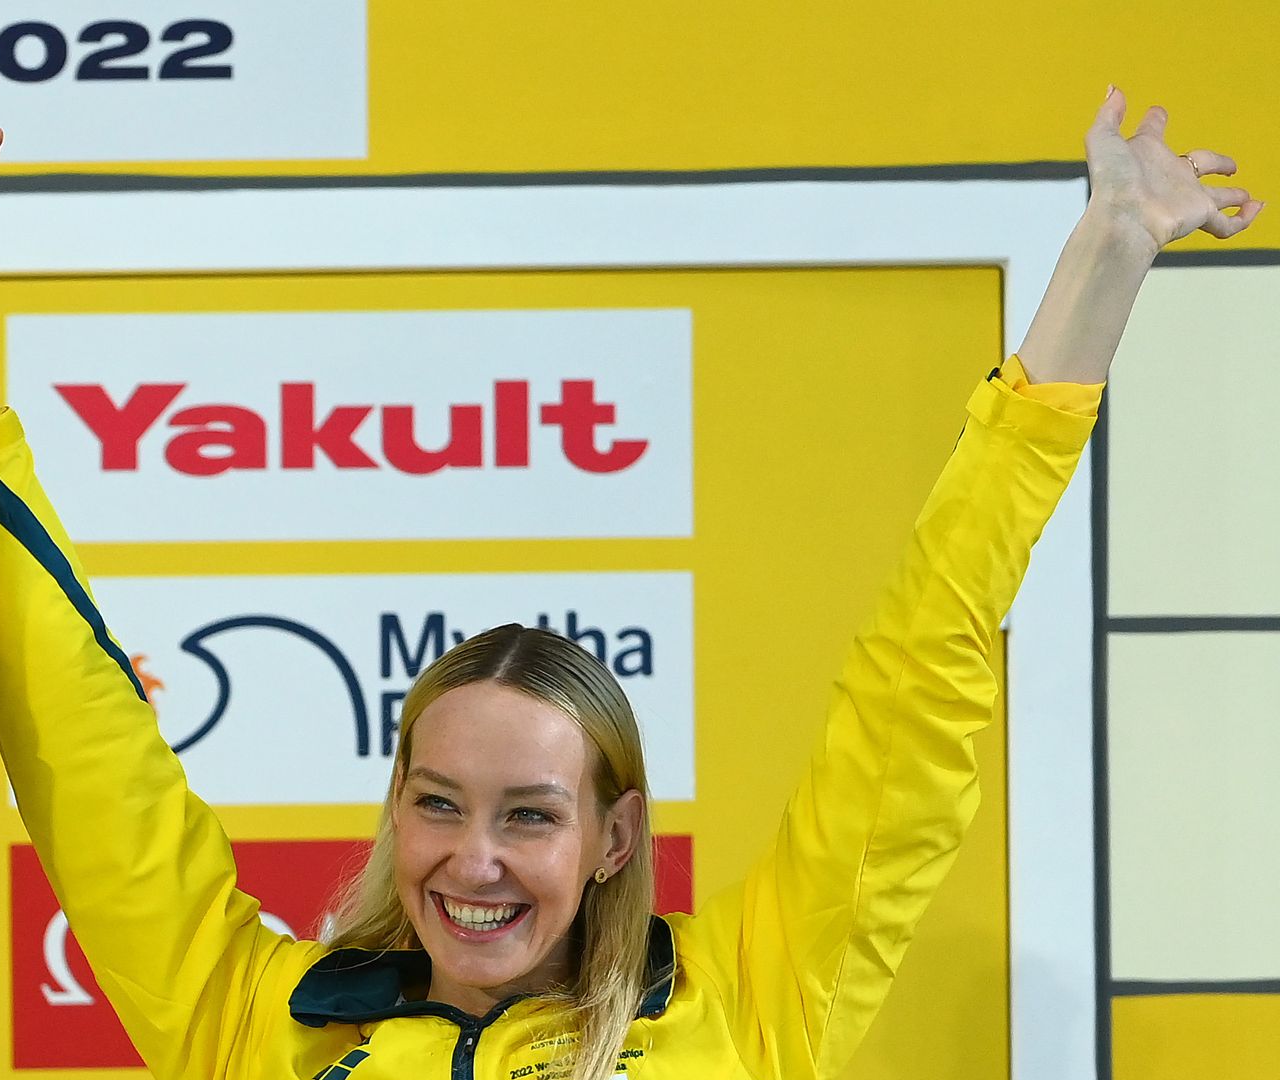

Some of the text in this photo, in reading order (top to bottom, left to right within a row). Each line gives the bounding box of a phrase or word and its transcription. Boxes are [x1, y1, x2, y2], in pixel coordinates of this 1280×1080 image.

[54, 378, 650, 477] Yakult
[380, 610, 653, 678] Mha
[509, 1066, 535, 1080] 2022
